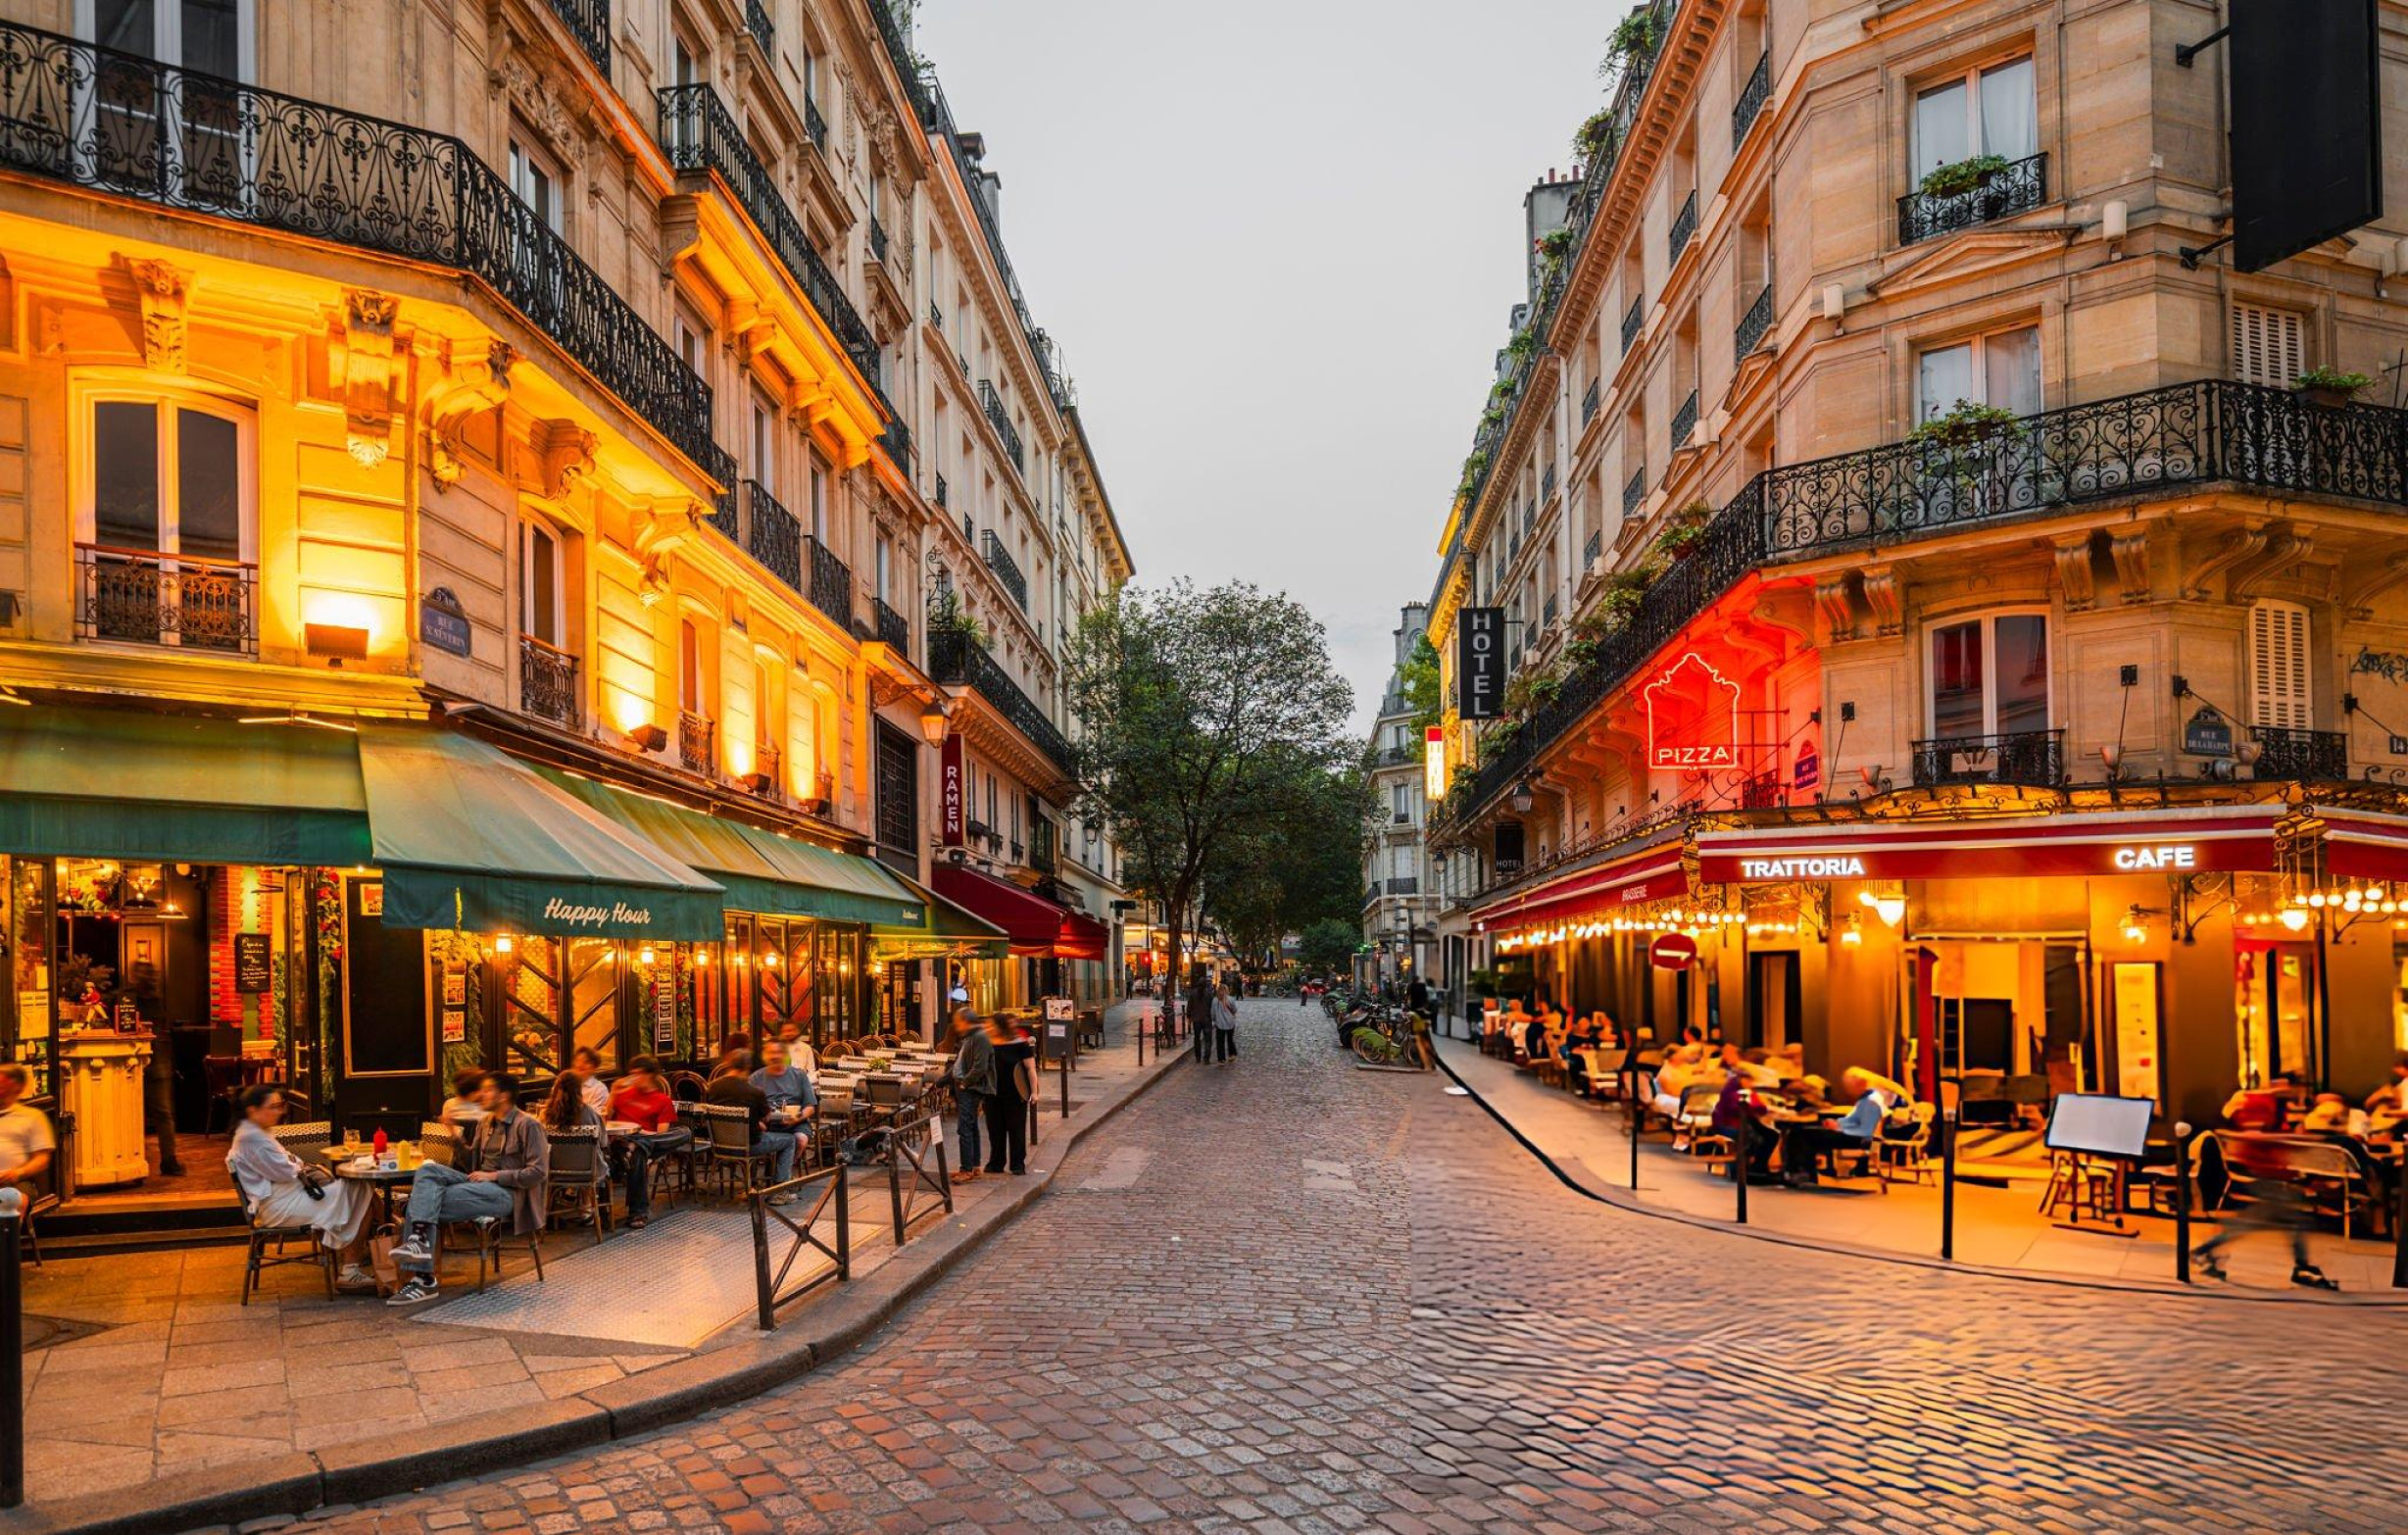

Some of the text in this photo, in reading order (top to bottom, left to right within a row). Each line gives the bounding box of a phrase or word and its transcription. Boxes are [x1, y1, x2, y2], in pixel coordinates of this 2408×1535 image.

[1472, 612, 1491, 716] HOTEL
[1657, 746, 1730, 764] PIZZA
[947, 766, 959, 834] RAMEN
[1741, 858, 1865, 878] TRATTORIA
[2115, 847, 2195, 868] CAFE
[544, 897, 651, 928] Happy Hour
